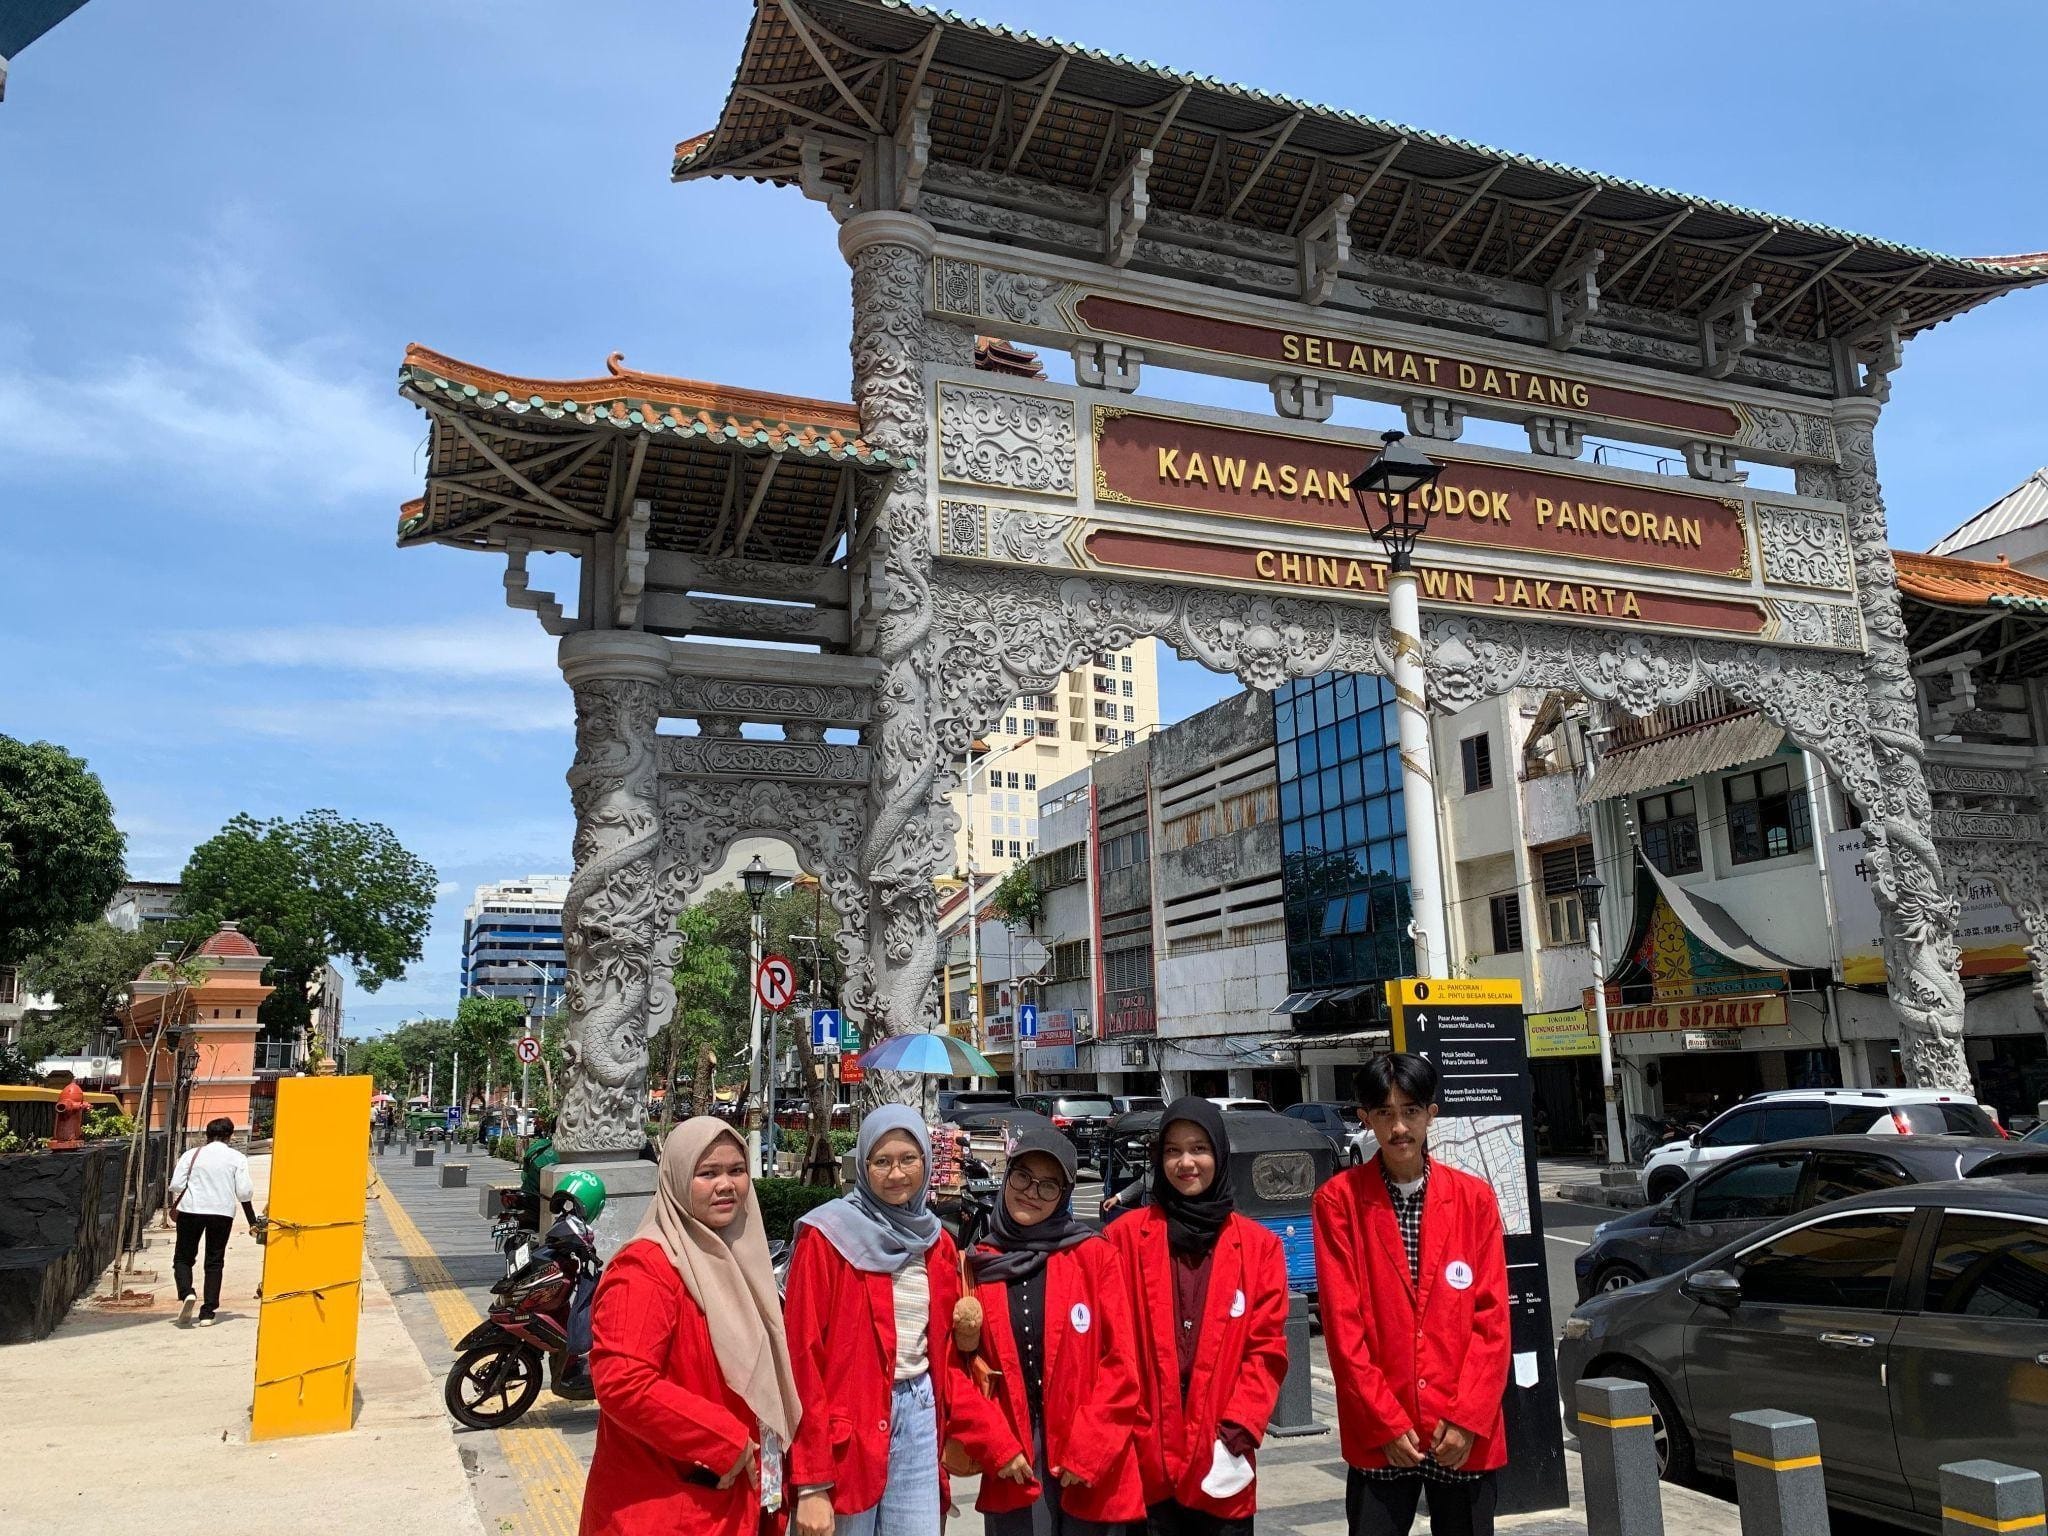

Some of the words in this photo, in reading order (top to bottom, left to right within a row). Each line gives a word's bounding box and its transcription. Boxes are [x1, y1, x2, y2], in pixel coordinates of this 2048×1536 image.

[1282, 334, 1440, 383] SELAMAT
[1459, 363, 1589, 407] DATANG
[1158, 447, 1350, 501] KAWASAN
[1378, 484, 1512, 522] ODOK
[1535, 497, 1702, 546] PANCORAN
[1256, 551, 1475, 600] CHINATWN
[1493, 576, 1642, 617] JAKARTA
[1531, 1025, 1555, 1034] GUNUNG
[1555, 1023, 1580, 1033] SELATAN
[1679, 1002, 1765, 1028] SEPAKAT
